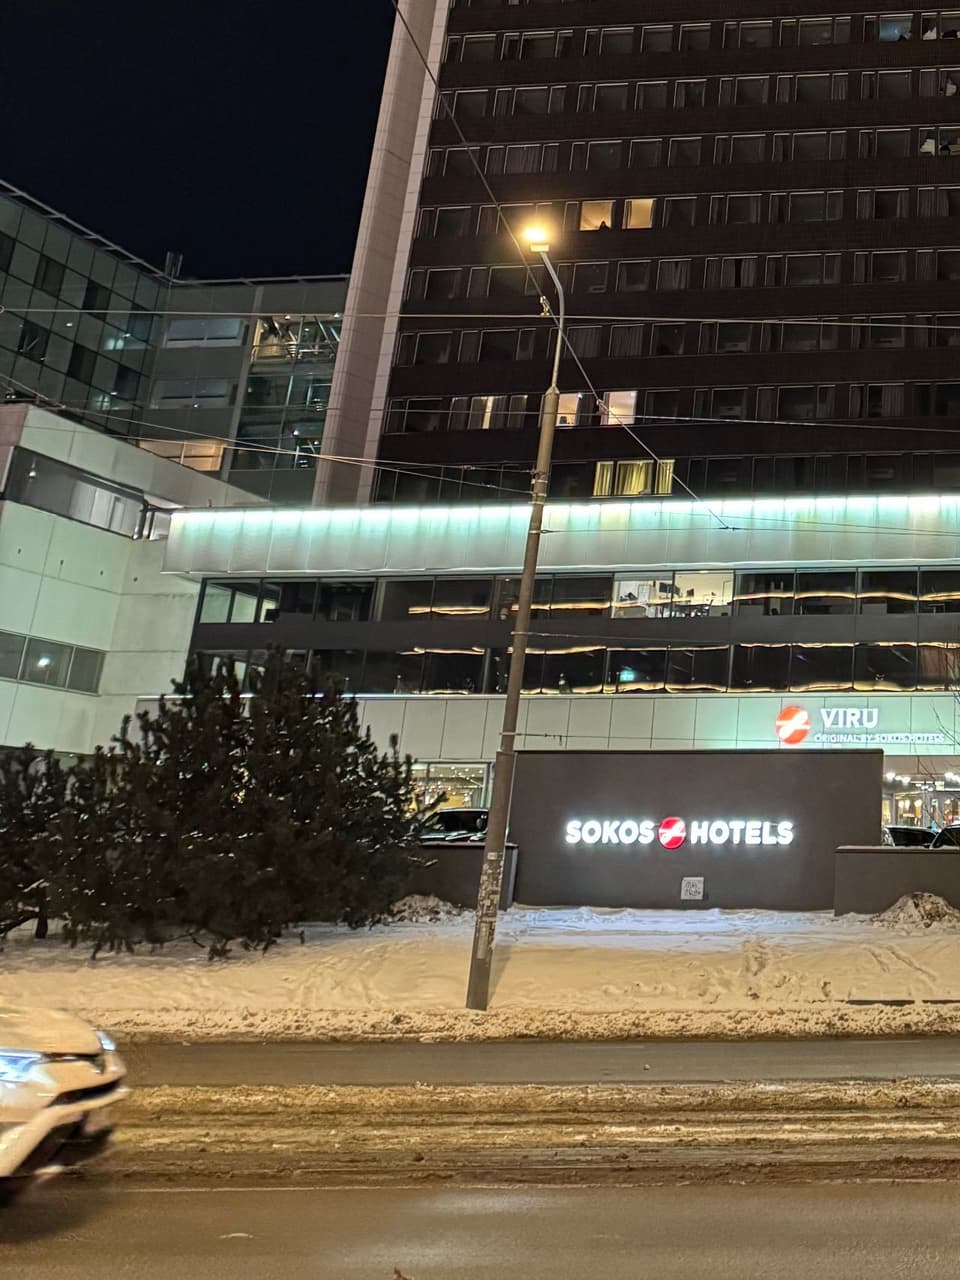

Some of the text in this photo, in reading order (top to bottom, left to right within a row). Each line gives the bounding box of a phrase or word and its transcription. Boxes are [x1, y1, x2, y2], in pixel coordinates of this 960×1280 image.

[820, 707, 879, 729] VIRU
[814, 732, 861, 743] ORIGINAL
[875, 732, 909, 743] SOKOS
[911, 732, 945, 743] HOTELS
[565, 820, 794, 845] SOKOS HOTELS
